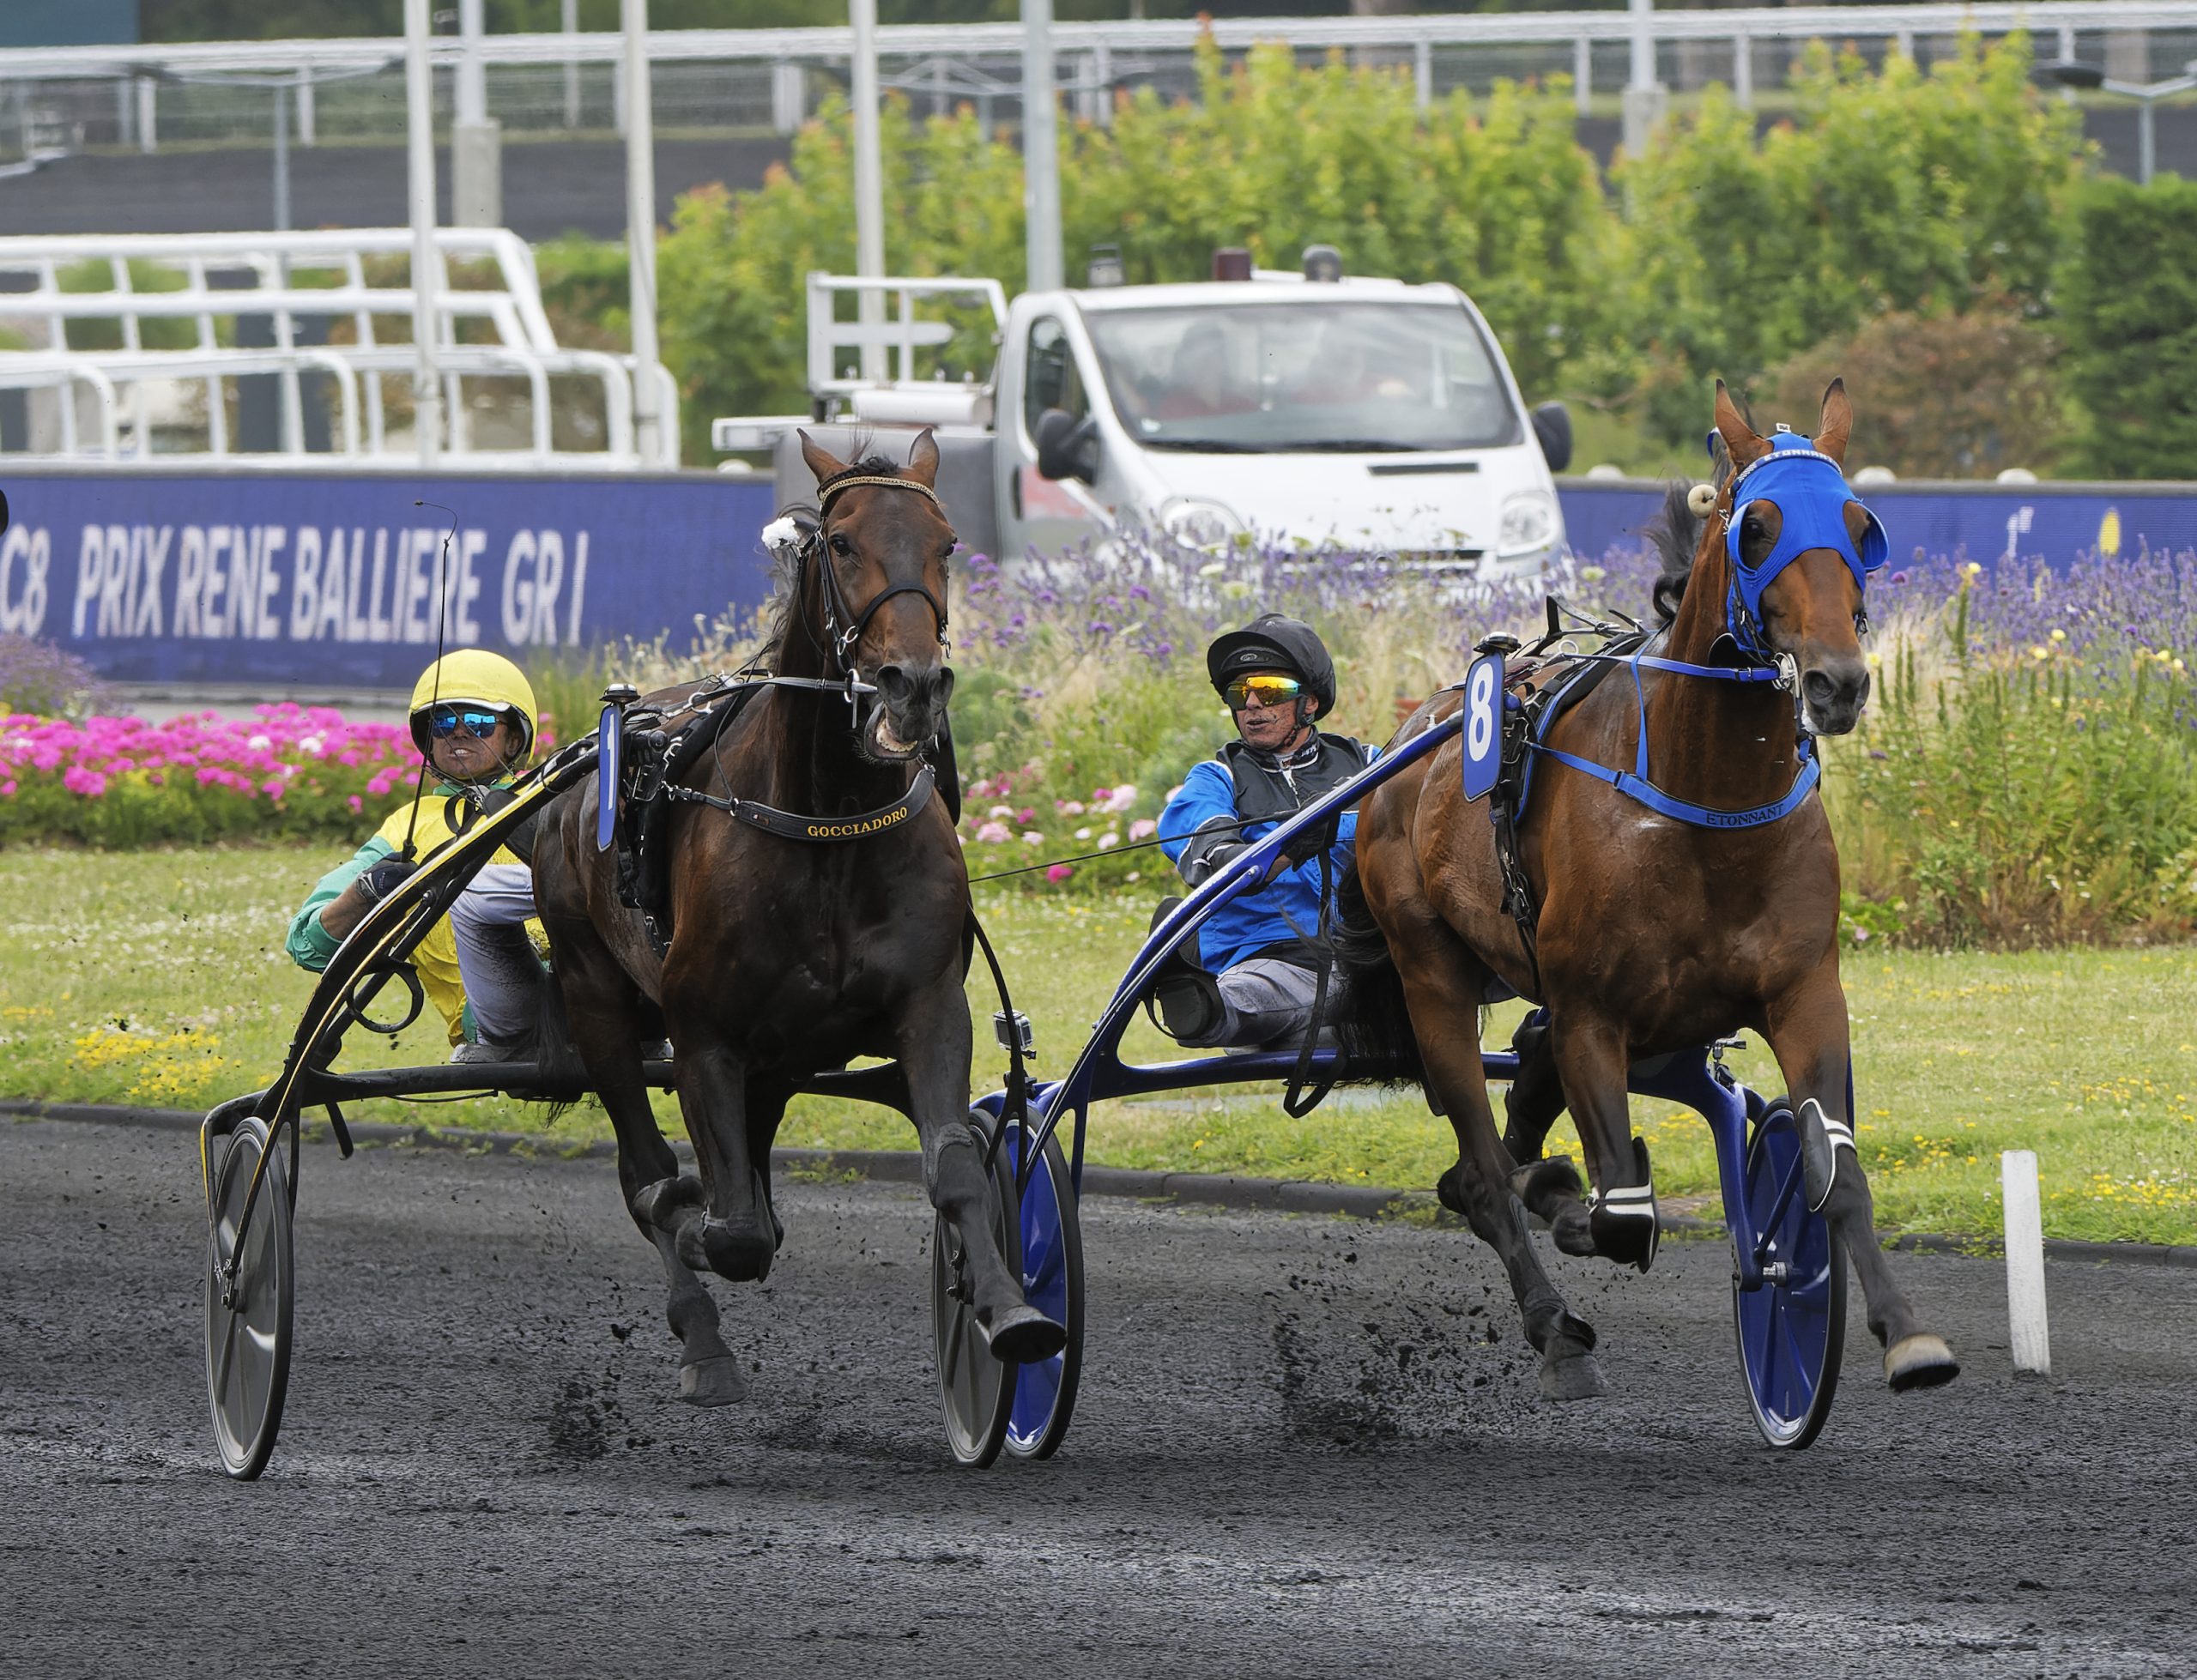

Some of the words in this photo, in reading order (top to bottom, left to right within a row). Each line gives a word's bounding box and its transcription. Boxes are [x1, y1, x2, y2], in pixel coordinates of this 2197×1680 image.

[72, 524, 173, 638] PRIX
[173, 525, 287, 639] RENE
[289, 526, 487, 644] BALLIERE
[501, 529, 565, 646] GR
[1468, 662, 1493, 762] 8
[607, 713, 615, 811] 1
[807, 807, 908, 837] GOCCIADORO
[1706, 804, 1784, 826] ETONNANT
